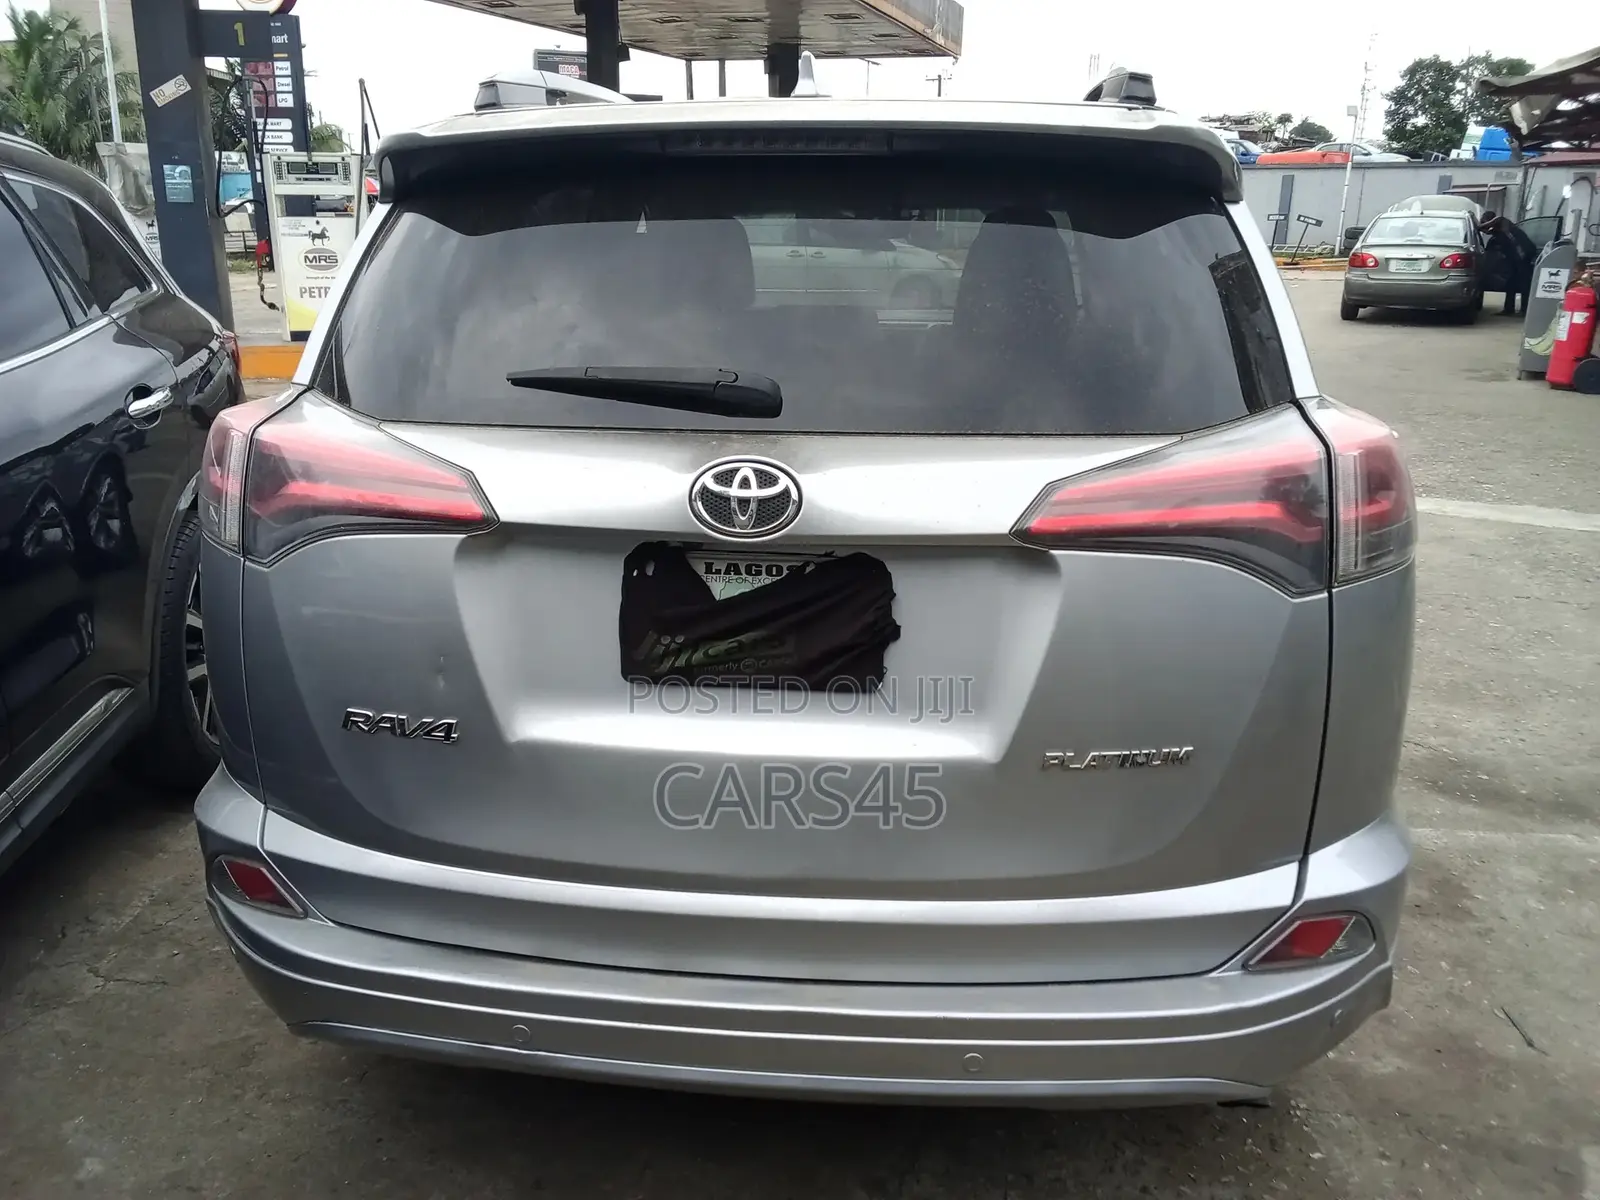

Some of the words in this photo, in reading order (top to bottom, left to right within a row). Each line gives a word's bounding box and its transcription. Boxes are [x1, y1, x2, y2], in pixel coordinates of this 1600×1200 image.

[233, 22, 245, 46] 1
[152, 89, 165, 104] NO
[304, 255, 339, 264] MRS
[342, 707, 459, 743] RAV4
[1040, 747, 1194, 770] PLATINUM
